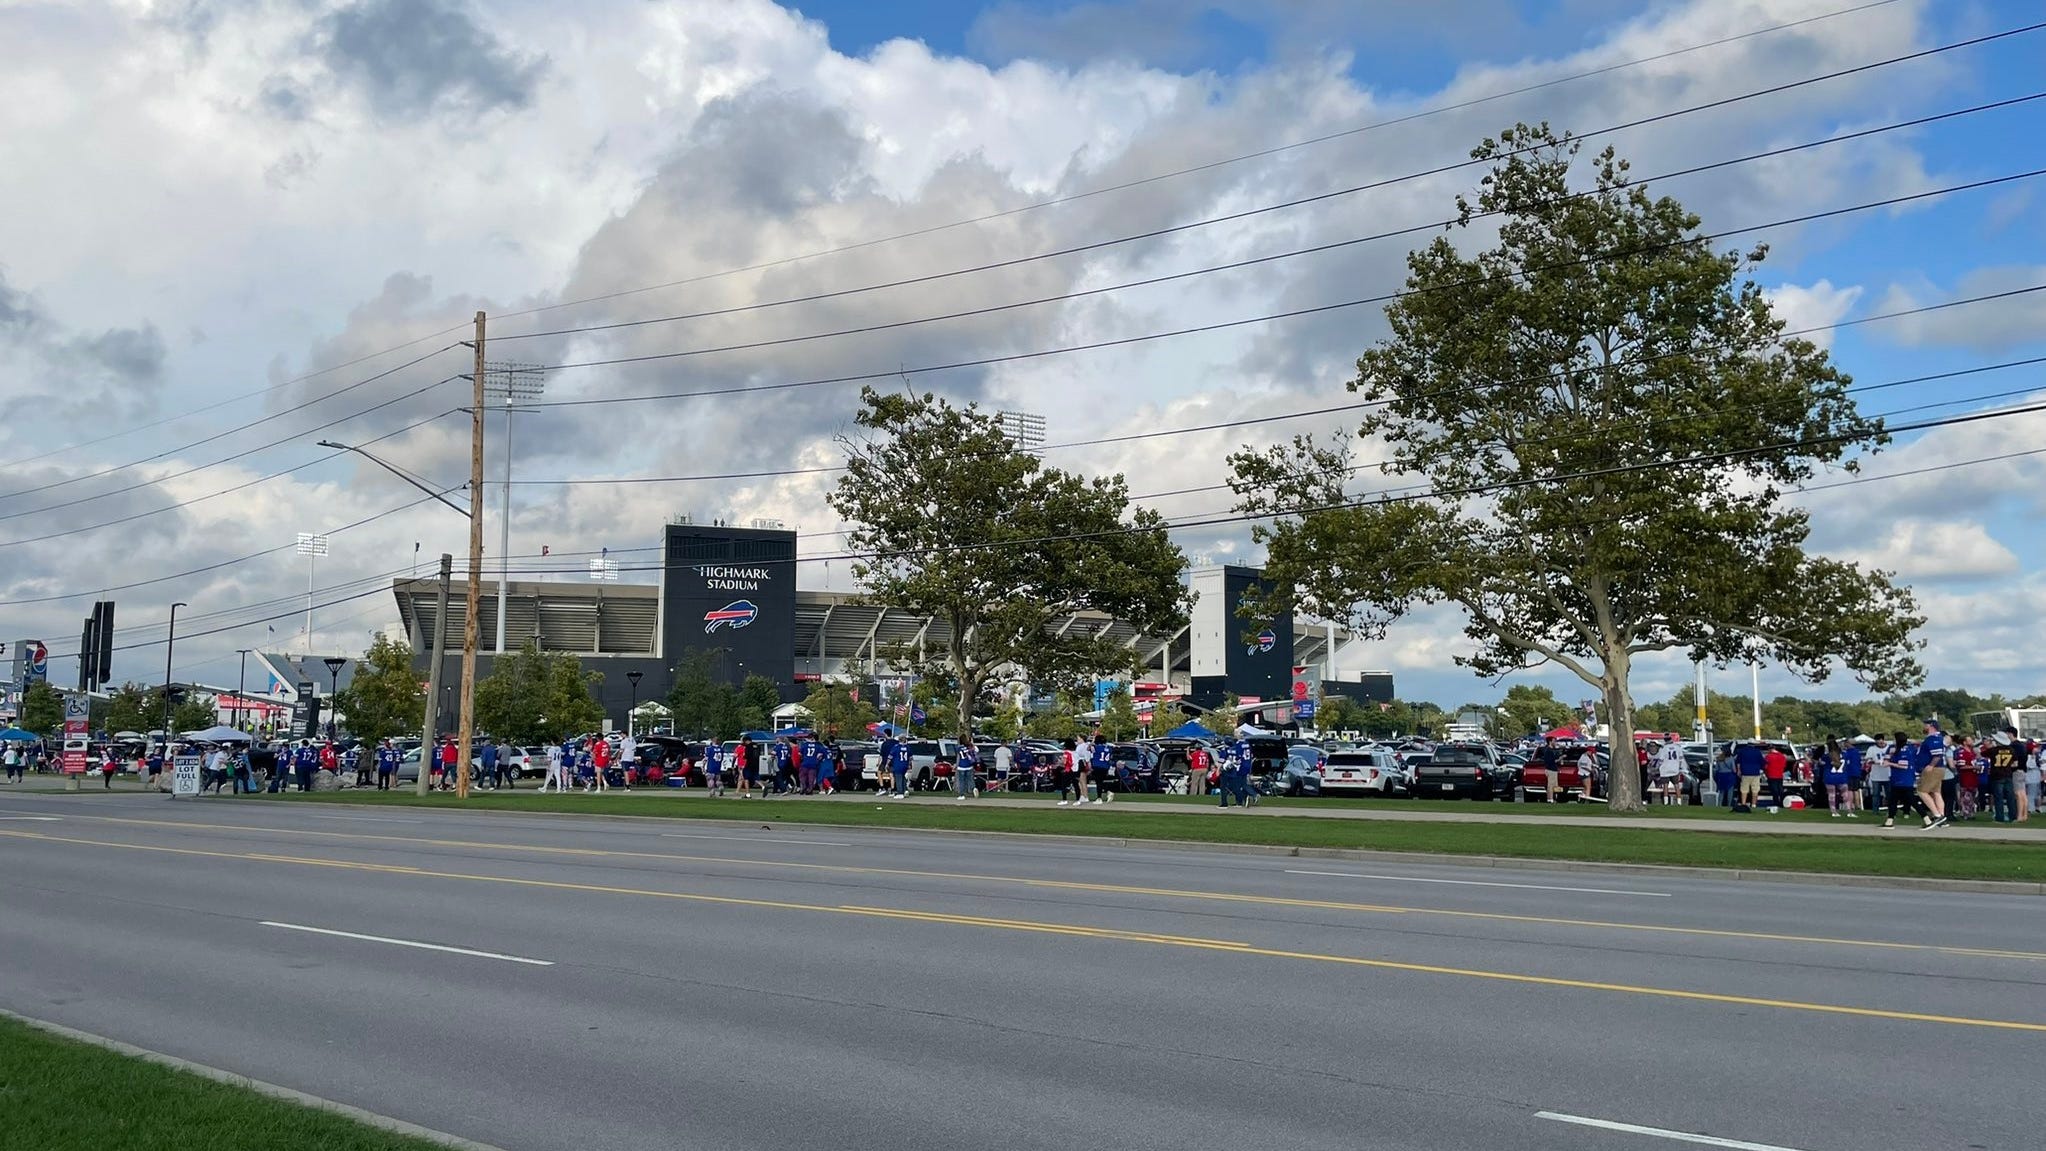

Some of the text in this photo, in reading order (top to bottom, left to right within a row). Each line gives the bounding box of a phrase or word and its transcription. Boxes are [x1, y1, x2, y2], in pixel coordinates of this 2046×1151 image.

[700, 566, 769, 579] HIGHMARK
[707, 579, 758, 590] STADIUM
[303, 752, 312, 760] 17
[806, 748, 816, 756] 17
[900, 752, 908, 761] 14
[1994, 754, 2013, 767] 17
